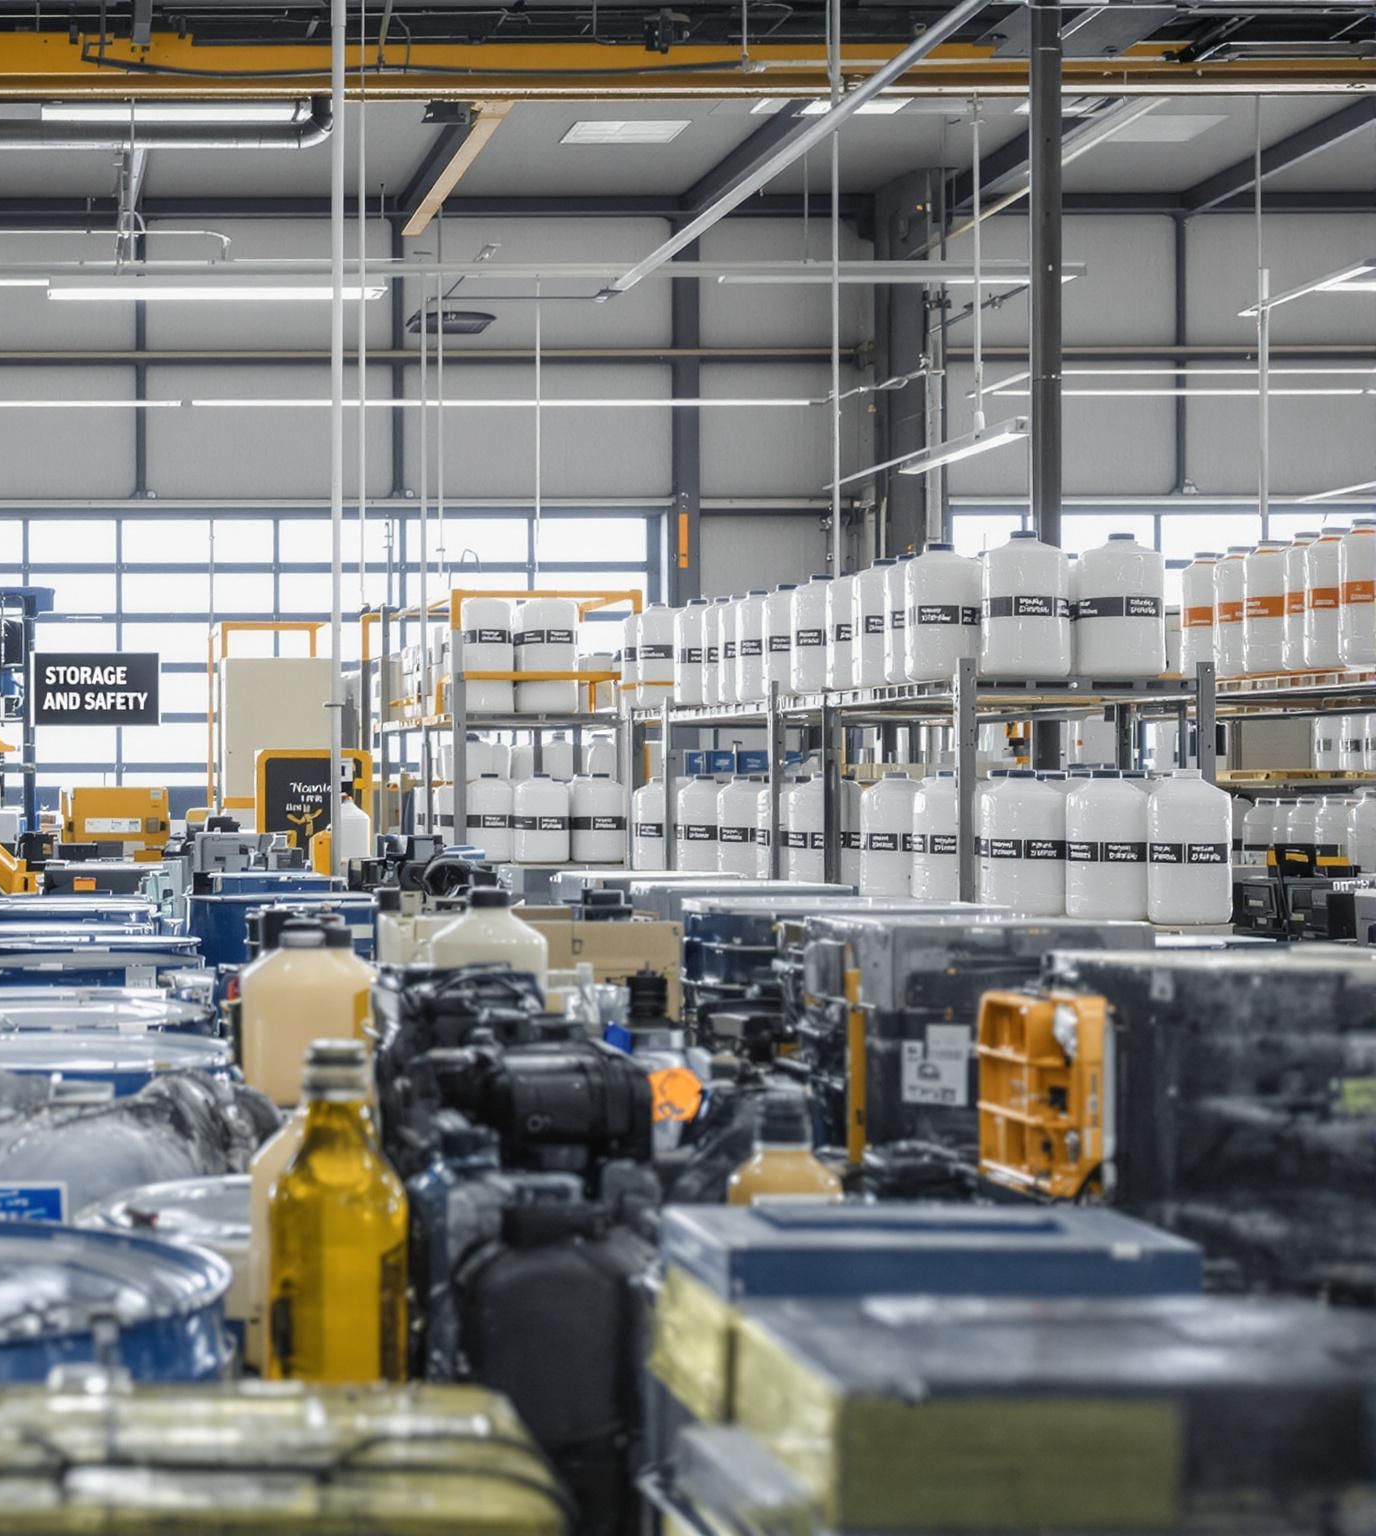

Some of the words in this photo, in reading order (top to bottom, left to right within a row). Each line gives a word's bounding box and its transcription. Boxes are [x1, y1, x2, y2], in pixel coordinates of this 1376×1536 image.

[45, 666, 127, 685] STORAGE
[42, 692, 81, 711] AND
[84, 692, 148, 711] SAFETY
